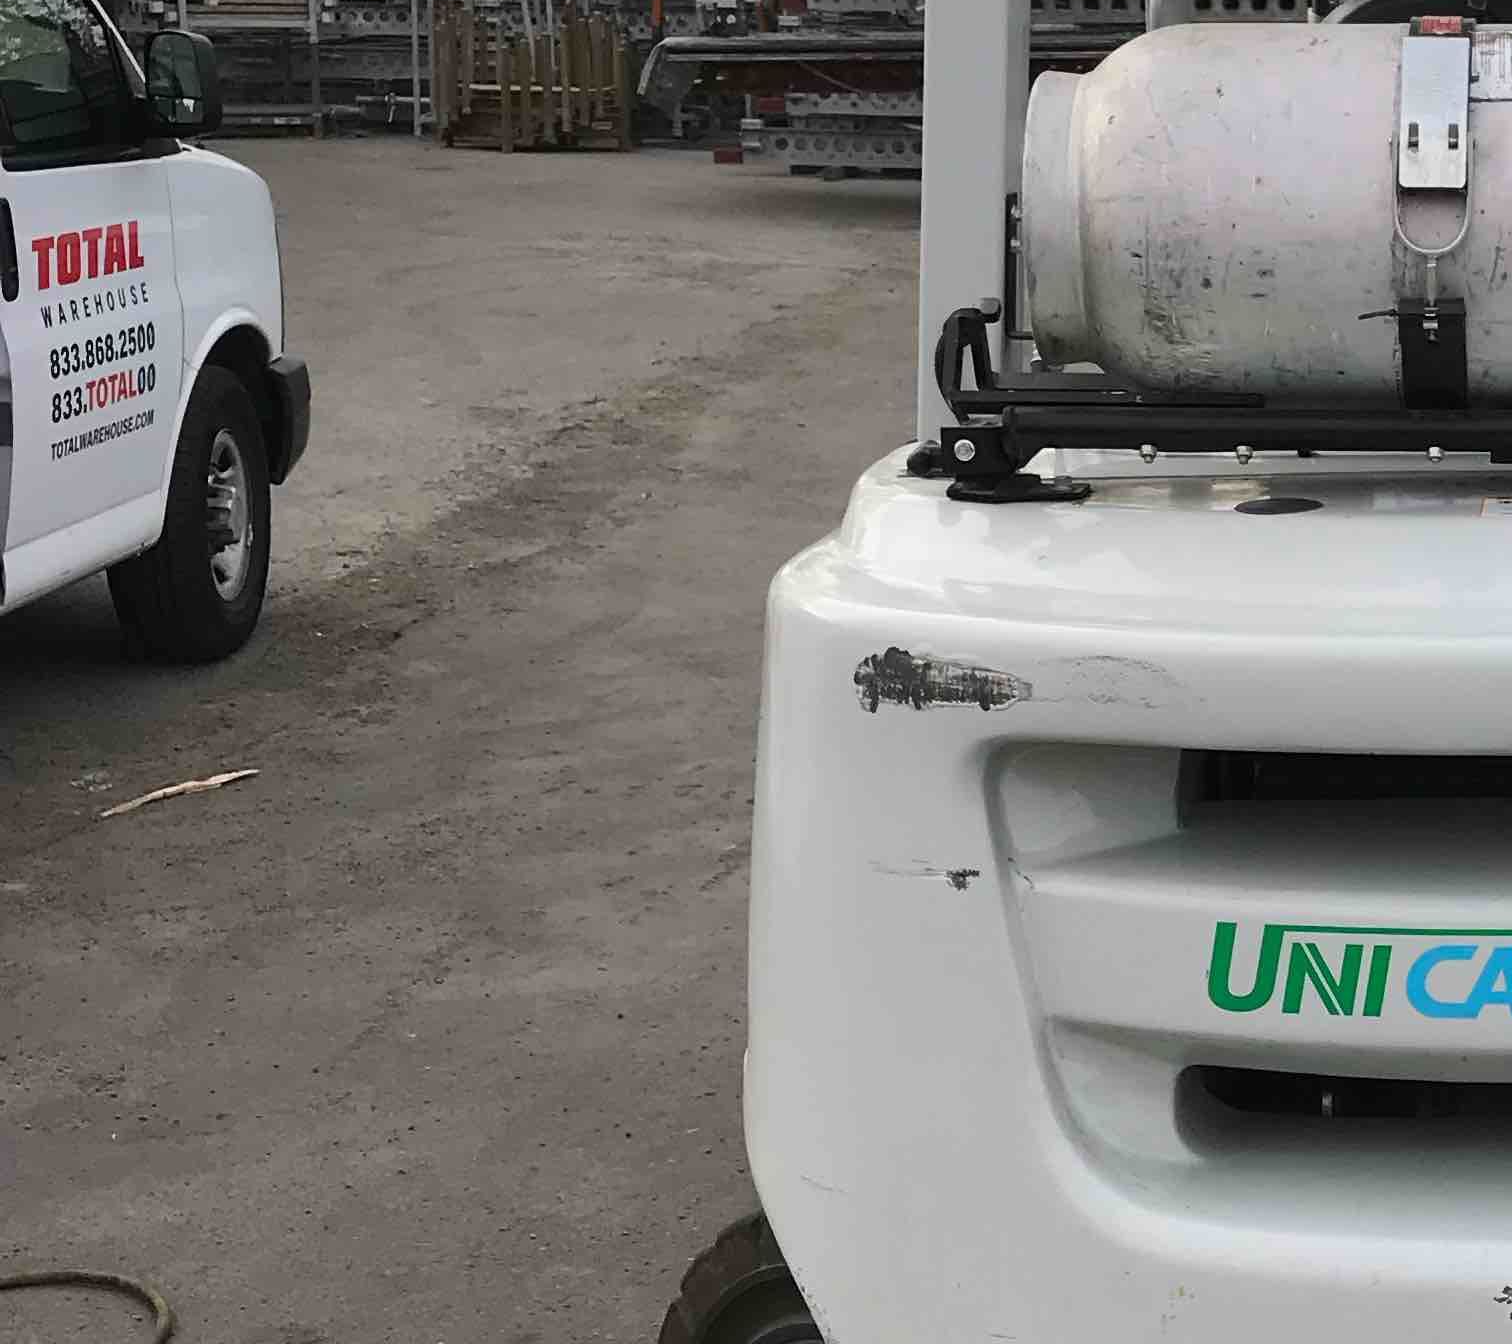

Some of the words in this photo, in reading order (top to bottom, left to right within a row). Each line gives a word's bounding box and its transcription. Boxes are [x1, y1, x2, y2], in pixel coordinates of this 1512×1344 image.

[31, 220, 145, 292] TOTAL
[41, 282, 150, 328] WAREHOUSE
[50, 322, 155, 380] 833.868.2500
[51, 363, 156, 423] 833.TOTAL00
[51, 409, 155, 461] TOTALWAREHOUSE.COM
